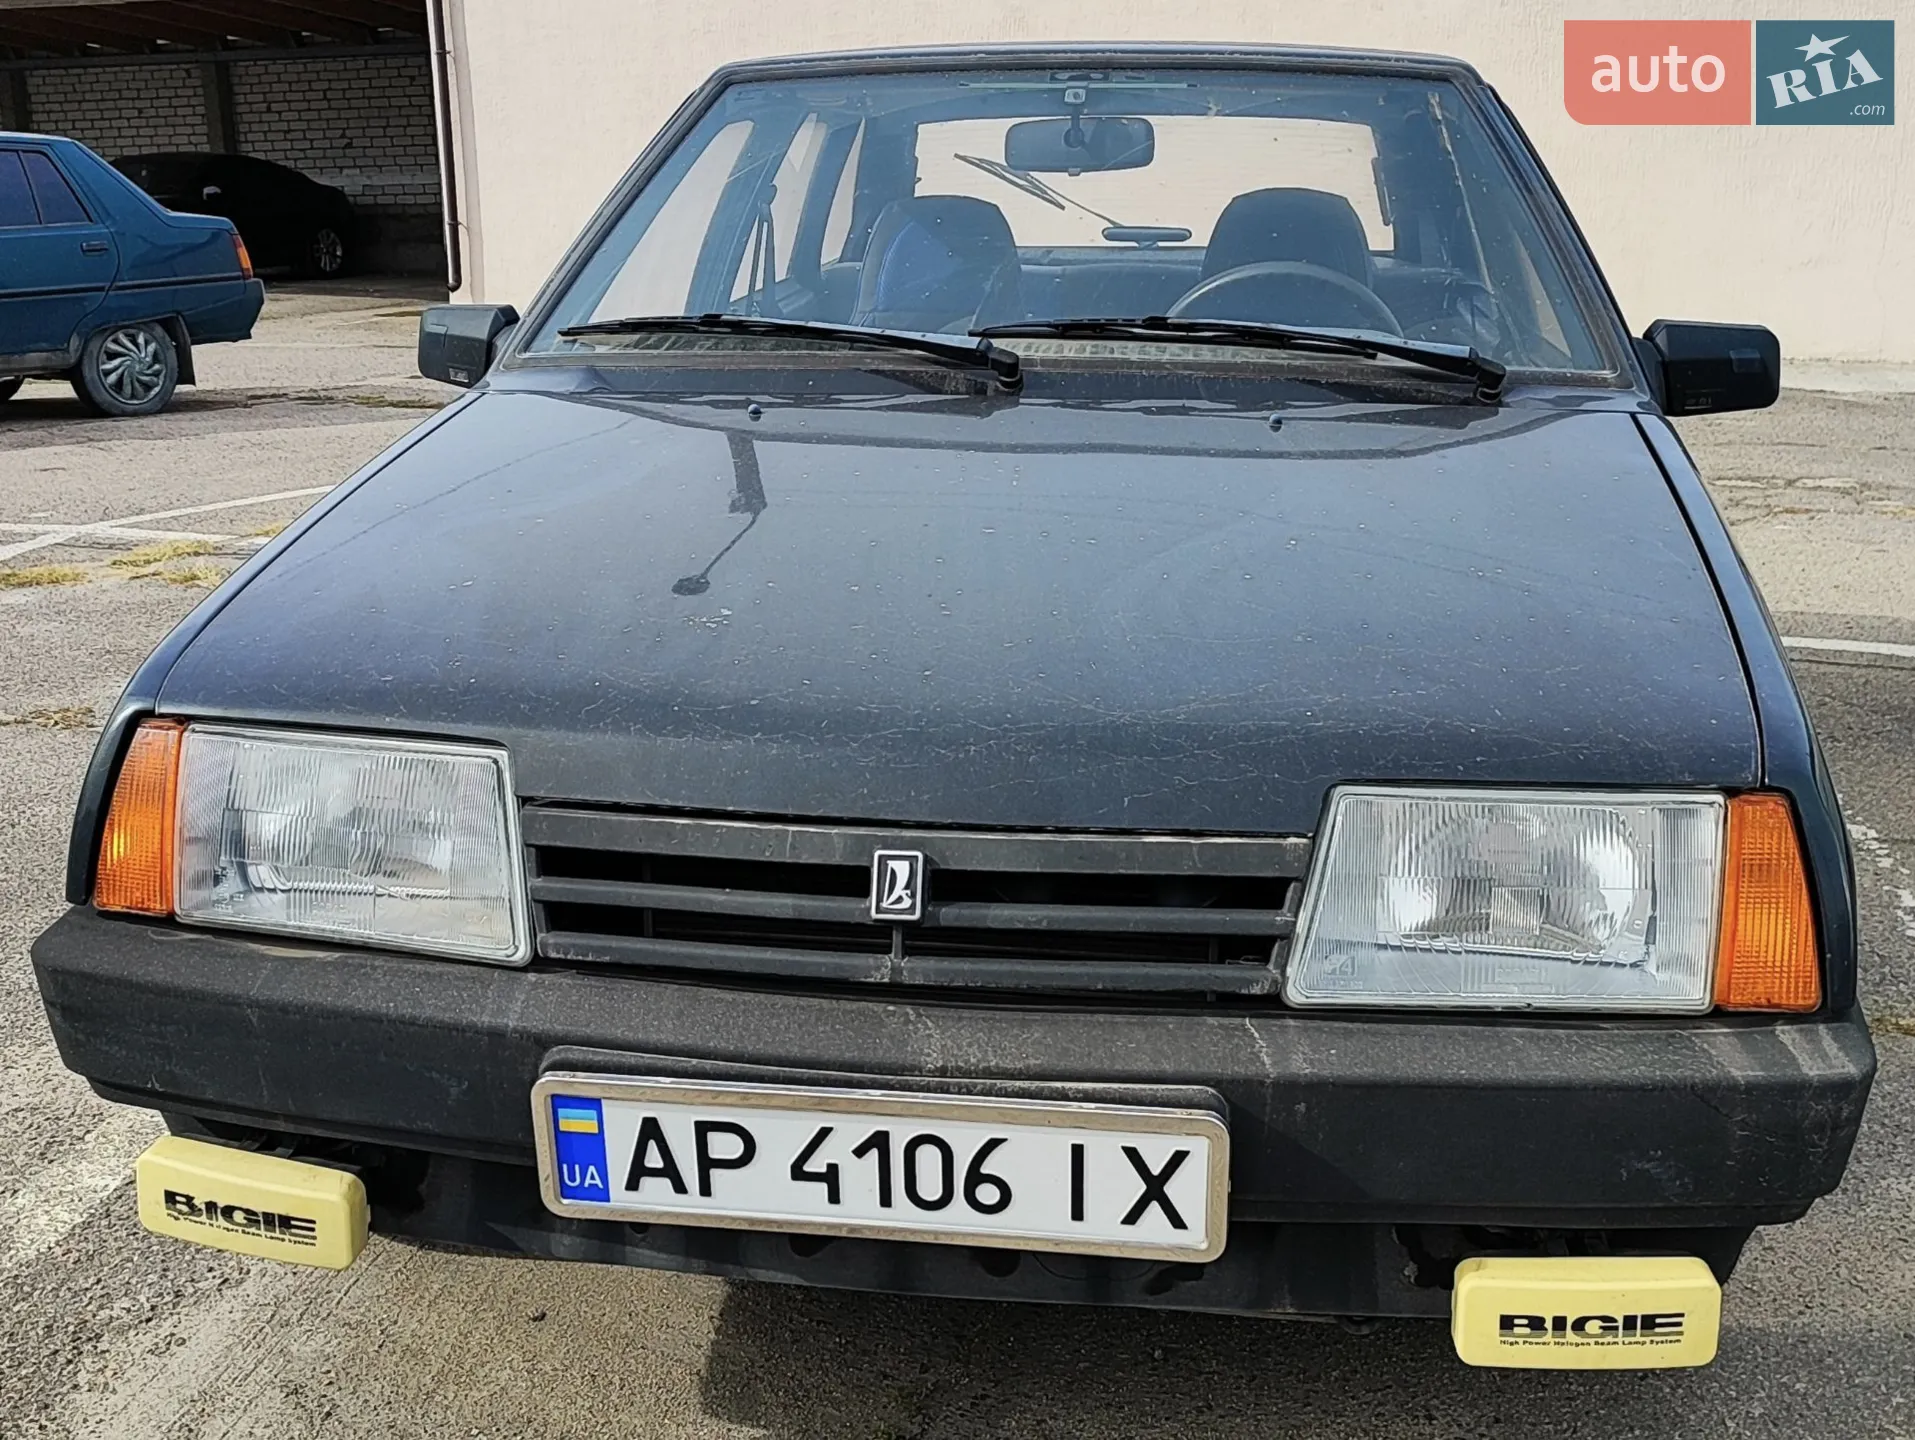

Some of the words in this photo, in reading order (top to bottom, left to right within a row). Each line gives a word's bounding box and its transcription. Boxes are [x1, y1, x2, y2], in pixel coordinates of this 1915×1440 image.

[562, 1163, 604, 1189] UA
[624, 1116, 757, 1198] AP
[790, 1126, 1013, 1215] 4106
[1499, 1313, 1685, 1338] BIGIE
[1500, 1339, 1520, 1347] High
[1621, 1339, 1648, 1347] Lamp
[1649, 1338, 1682, 1346] System
